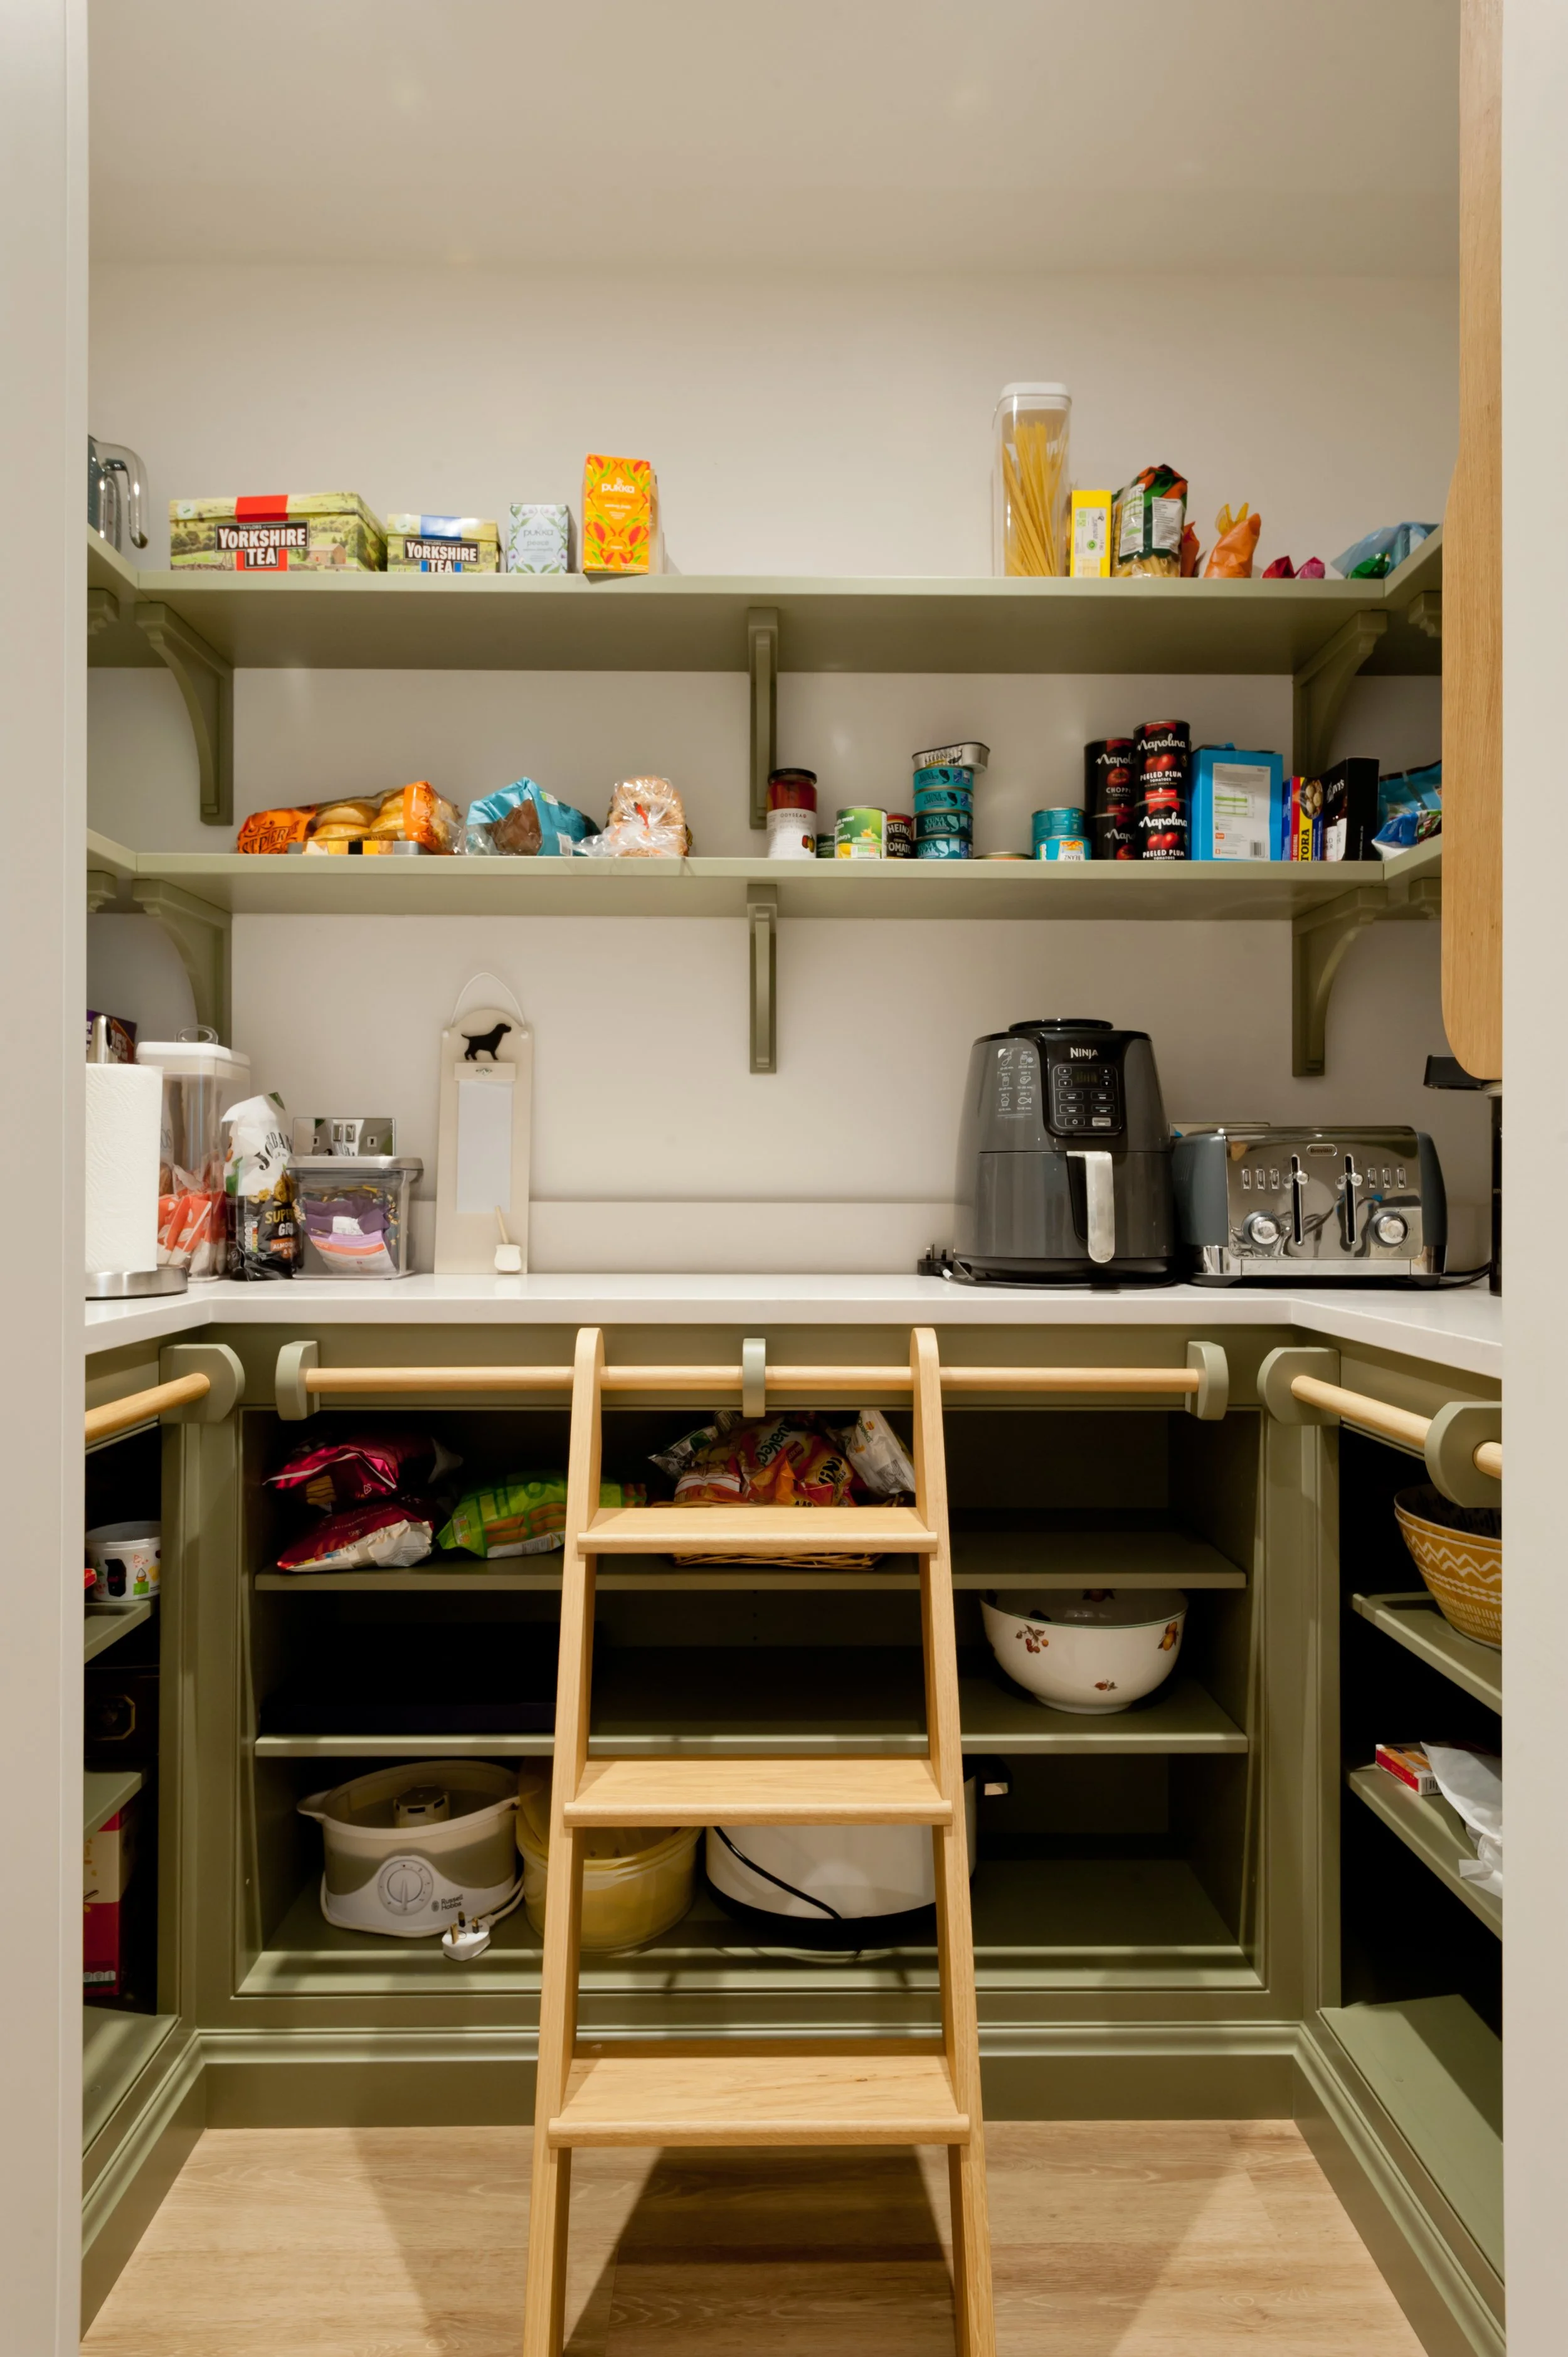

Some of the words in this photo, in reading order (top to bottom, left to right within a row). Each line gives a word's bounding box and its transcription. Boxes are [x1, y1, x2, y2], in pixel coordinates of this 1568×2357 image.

[601, 478, 635, 494] pukka
[218, 528, 306, 549] YORKSHIRE
[523, 529, 554, 538] pukka
[247, 548, 276, 565] TEA
[406, 541, 477, 561] YORKSHIRE
[430, 560, 452, 573] TEA
[1136, 733, 1185, 752] Napolina
[1096, 753, 1136, 767] Napol
[1140, 771, 1163, 781] PEELED
[1138, 812, 1187, 829] Napolina
[887, 824, 910, 837] HEINZ
[887, 842, 911, 854] OMATO
[1301, 828, 1310, 861] TORA
[1143, 849, 1167, 858] PEELED
[1070, 1047, 1098, 1059] NINJA
[441, 1894, 464, 1904] Russell
[441, 1901, 462, 1911] Hobbs
